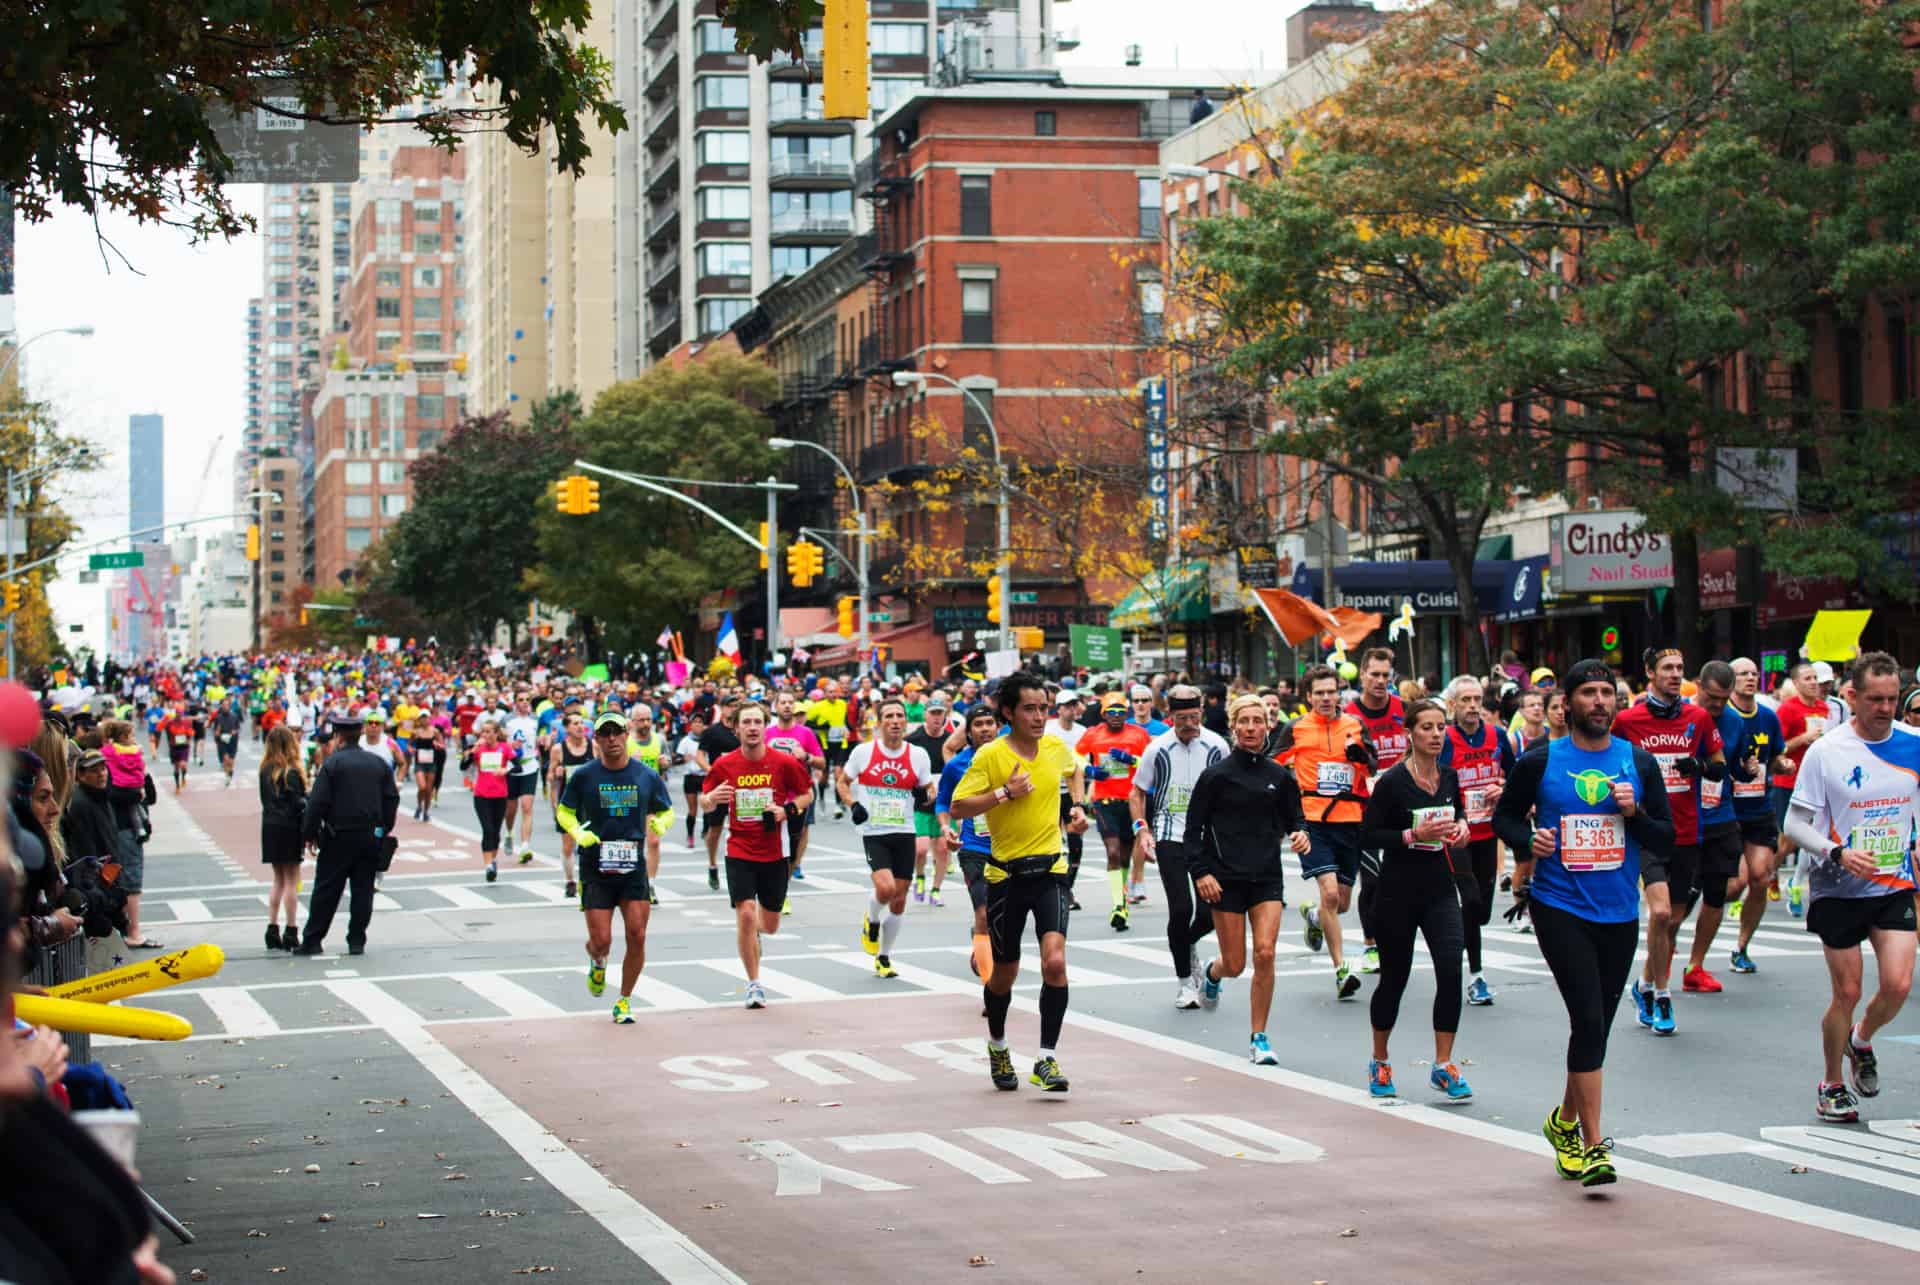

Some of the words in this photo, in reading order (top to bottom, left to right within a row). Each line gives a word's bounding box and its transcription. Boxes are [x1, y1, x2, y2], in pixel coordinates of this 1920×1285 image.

[1588, 566, 1625, 582] Nail
[1630, 563, 1676, 579] Studi
[1641, 734, 1692, 749] NORWAY
[869, 760, 909, 780] ITALIA
[737, 774, 772, 791] GOOFY
[1575, 820, 1600, 829] ING
[1575, 831, 1615, 847] 5-363
[1864, 829, 1886, 838] ING
[1861, 837, 1900, 852] 17-027
[744, 1114, 1328, 1197] ONLY
